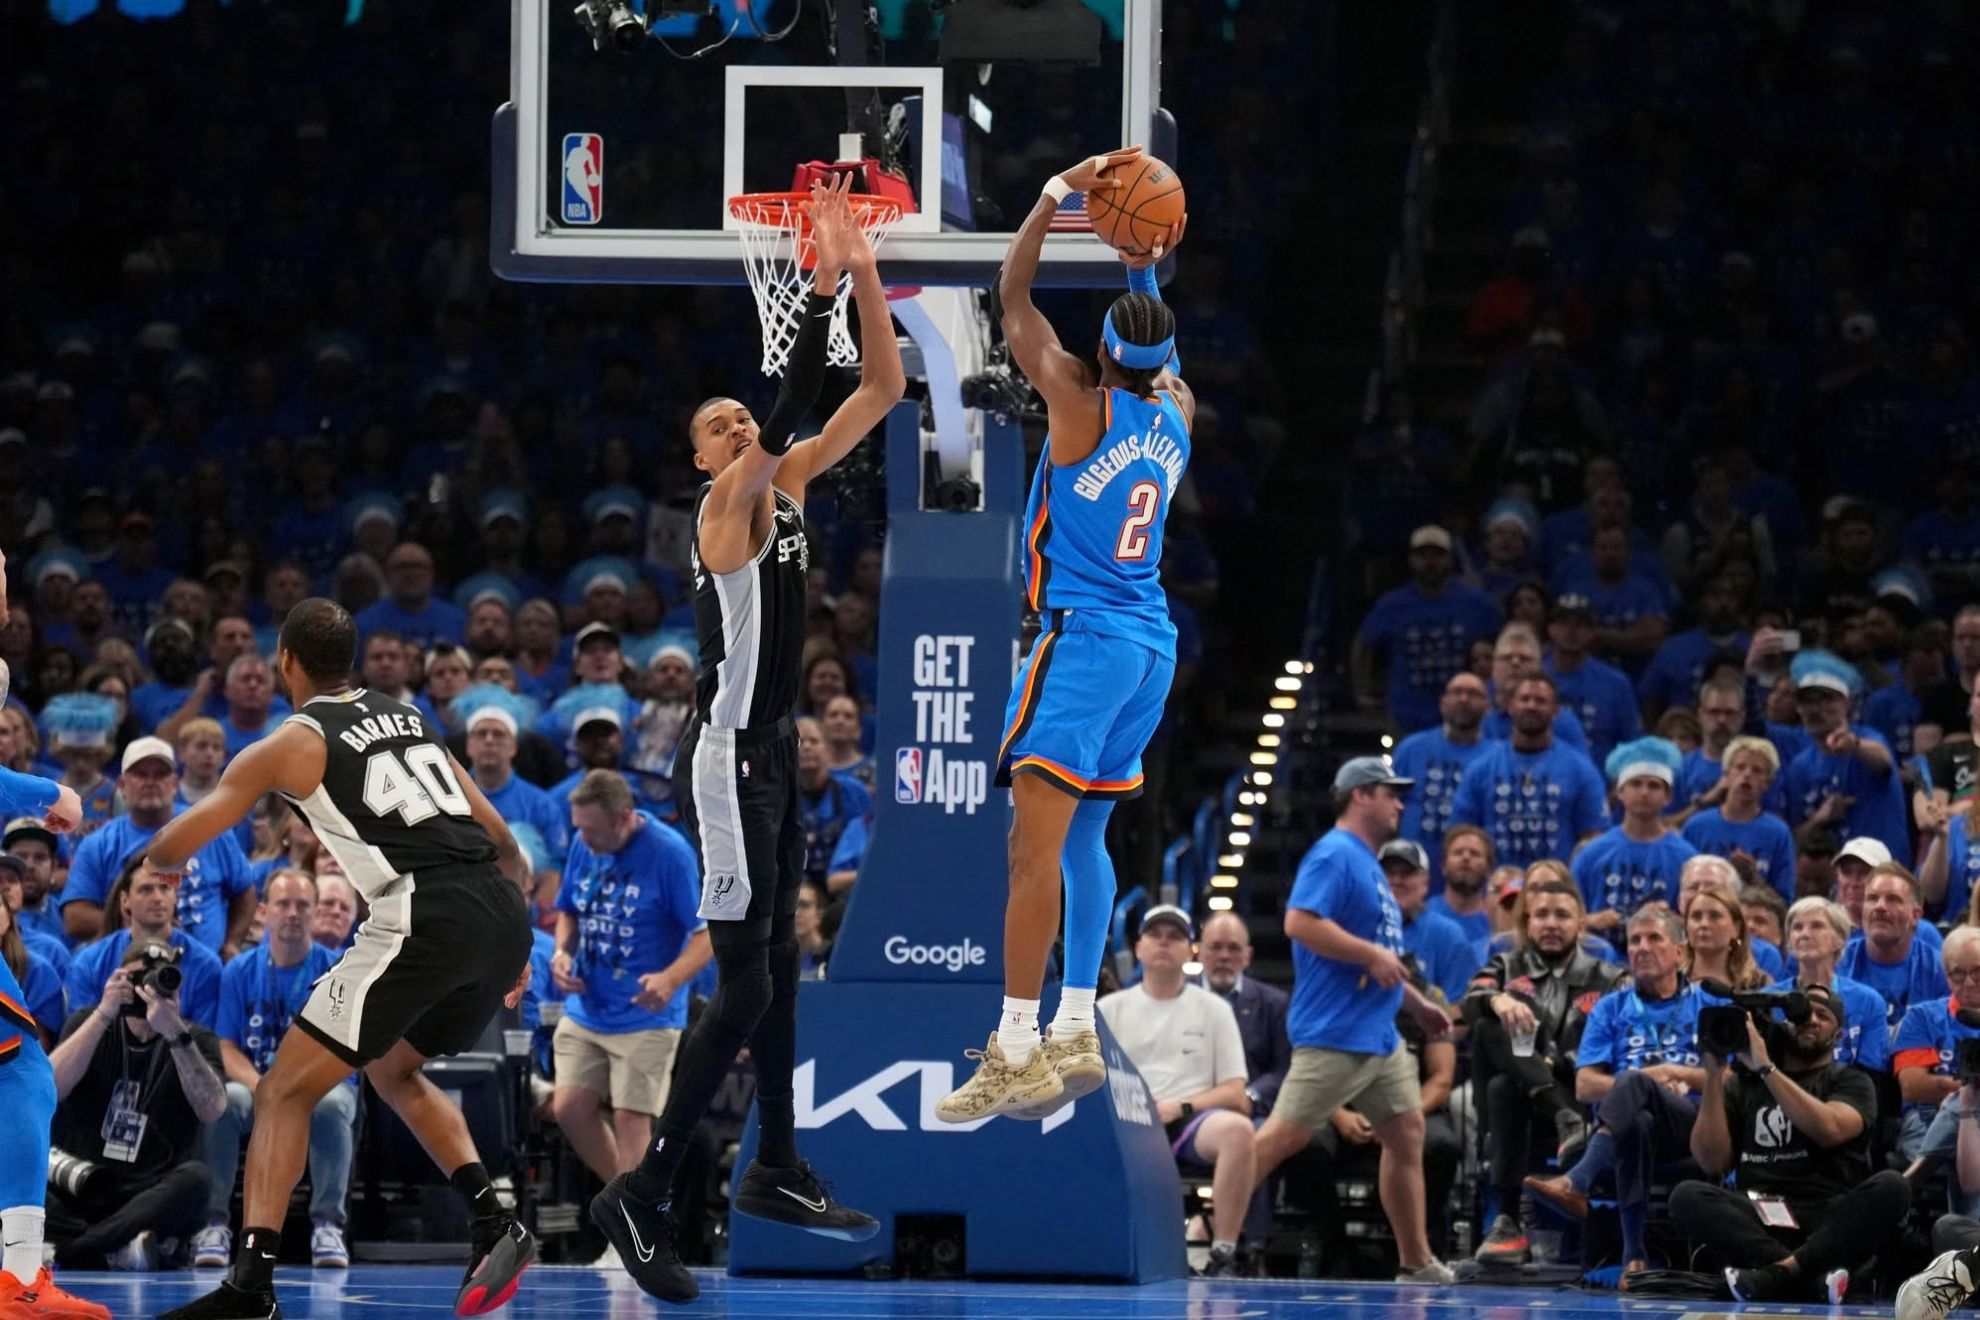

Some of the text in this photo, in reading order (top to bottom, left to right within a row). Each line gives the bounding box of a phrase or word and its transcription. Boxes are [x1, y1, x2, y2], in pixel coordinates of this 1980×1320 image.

[1114, 480, 1160, 561] 2
[913, 634, 976, 687] GET
[339, 713, 424, 753] BARNES
[911, 691, 975, 744] THE
[362, 743, 472, 827] 40
[924, 749, 988, 815] App
[884, 935, 987, 972] Google
[793, 1058, 1075, 1135] KI
